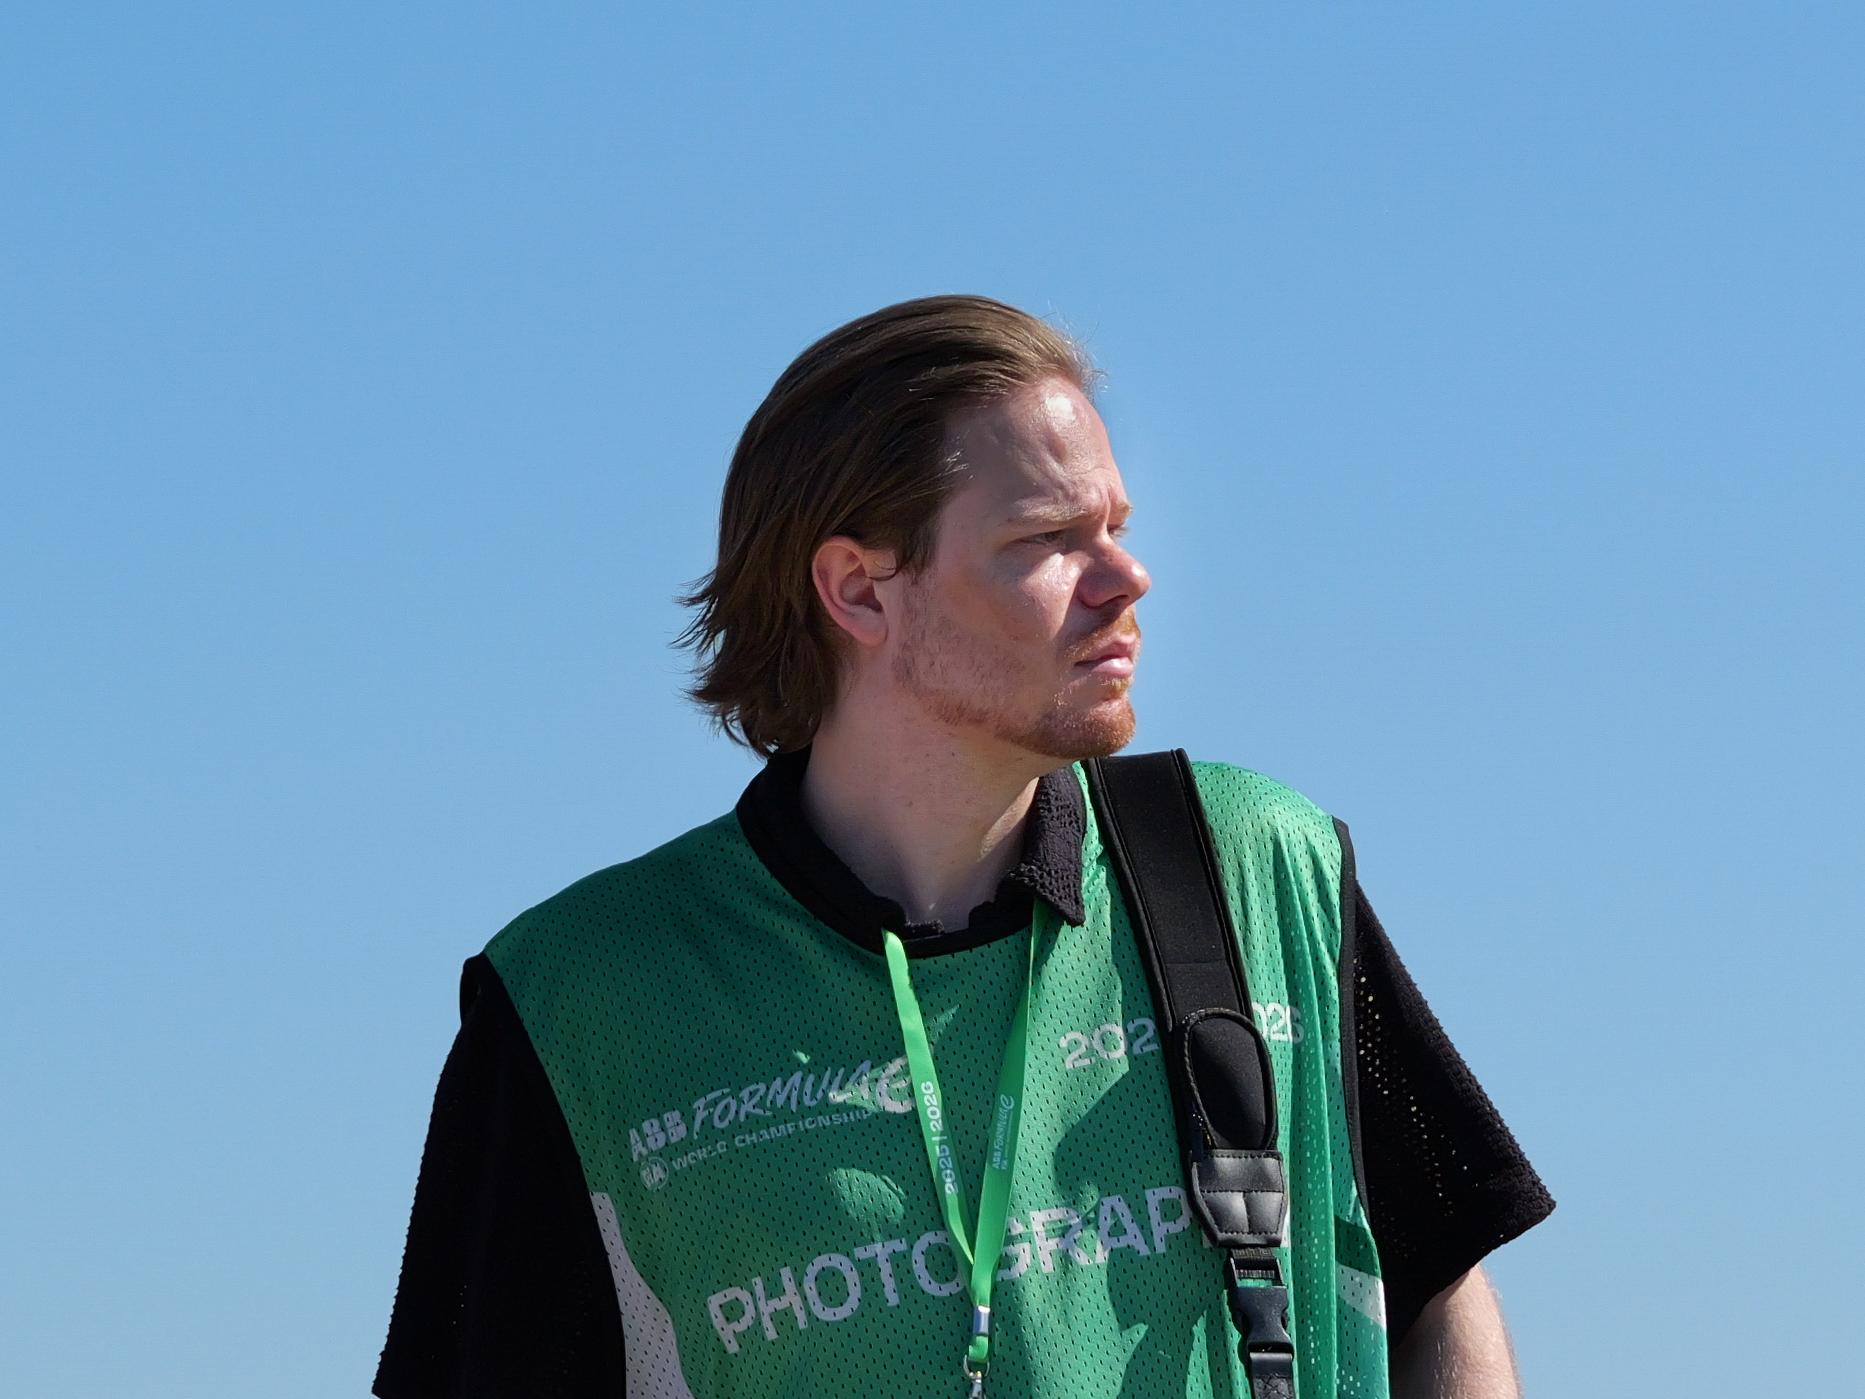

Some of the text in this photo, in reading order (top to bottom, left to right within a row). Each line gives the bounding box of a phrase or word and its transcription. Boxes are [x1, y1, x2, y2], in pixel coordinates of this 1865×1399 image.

[1059, 1017, 1160, 1069] 202
[629, 1109, 687, 1162] ABB
[692, 1059, 872, 1140] FORMULA
[672, 1140, 727, 1171] WORLD
[735, 1109, 874, 1148] CHAMPIONSHIP
[920, 1080, 959, 1195] 2025 2026
[707, 1185, 1192, 1355] PHOTOGRAP
